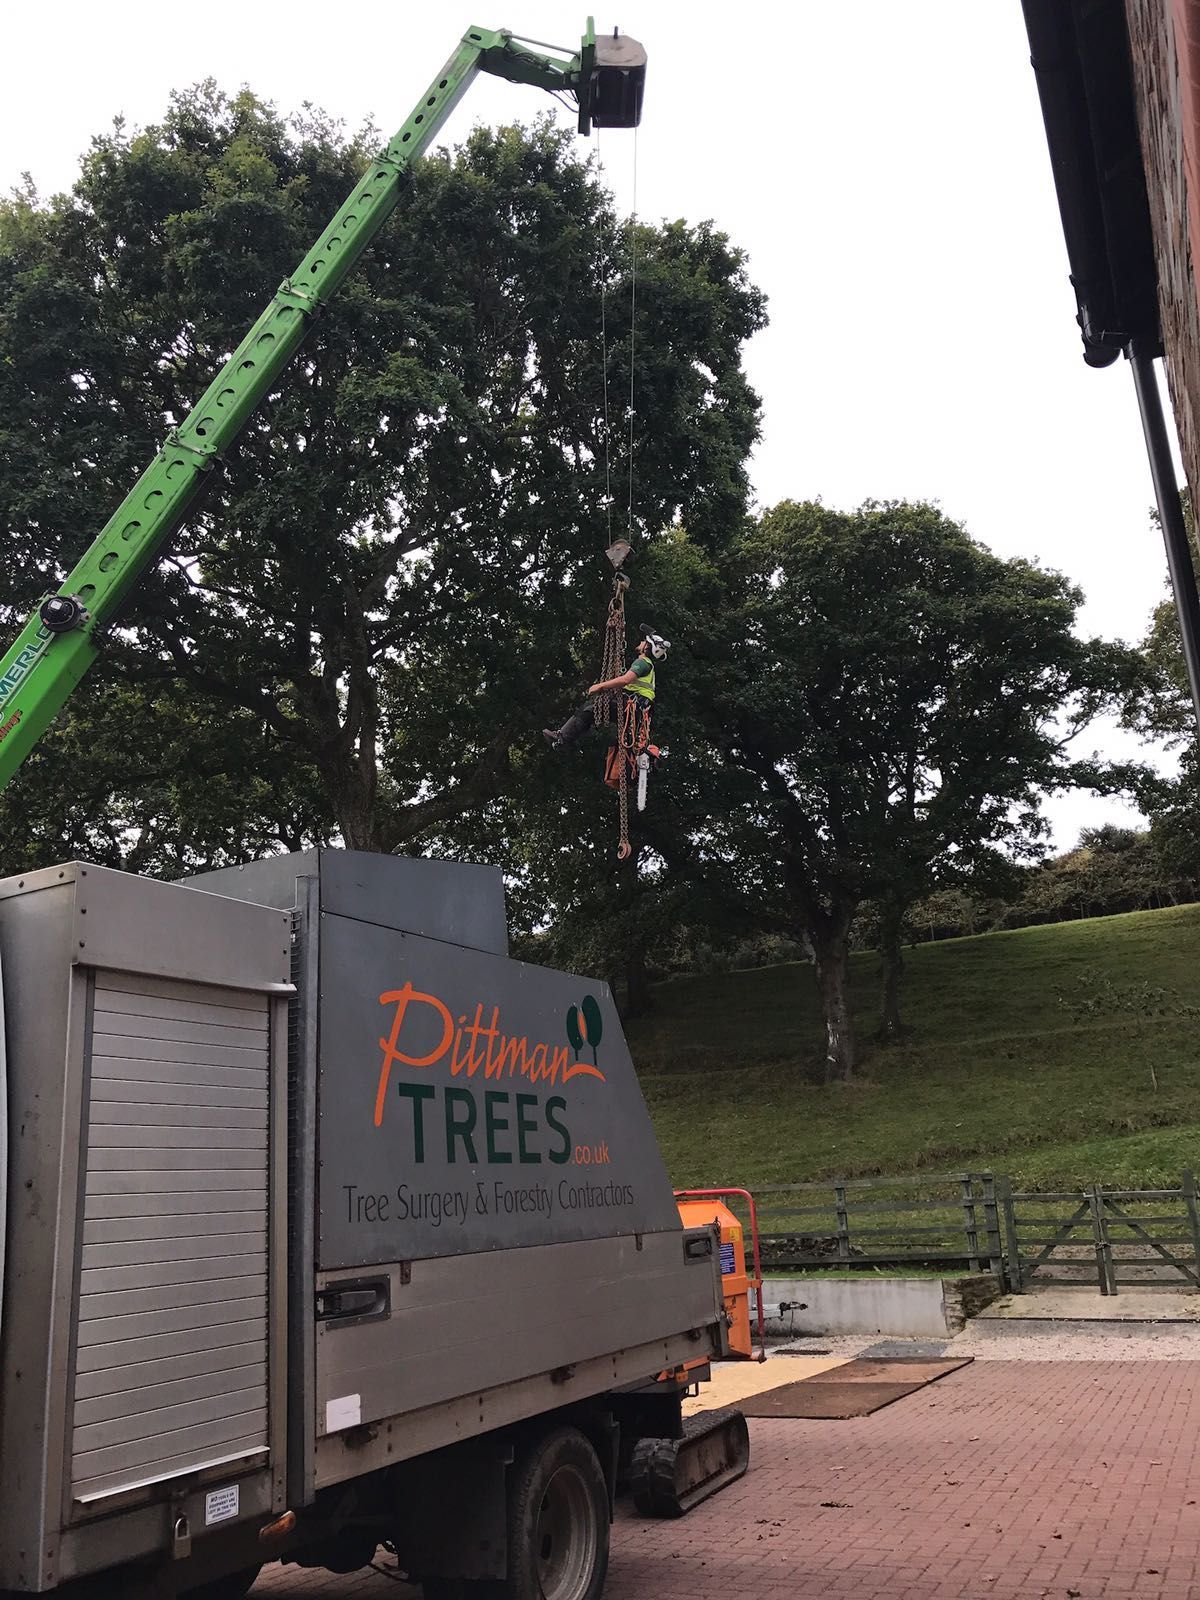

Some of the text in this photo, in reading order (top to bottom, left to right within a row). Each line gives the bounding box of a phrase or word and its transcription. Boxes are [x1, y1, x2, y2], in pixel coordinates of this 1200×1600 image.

[374, 981, 606, 1127] Pittman
[398, 1082, 571, 1165] TREES
[343, 1180, 634, 1227] Tree Surgery & Forestry Contractors
